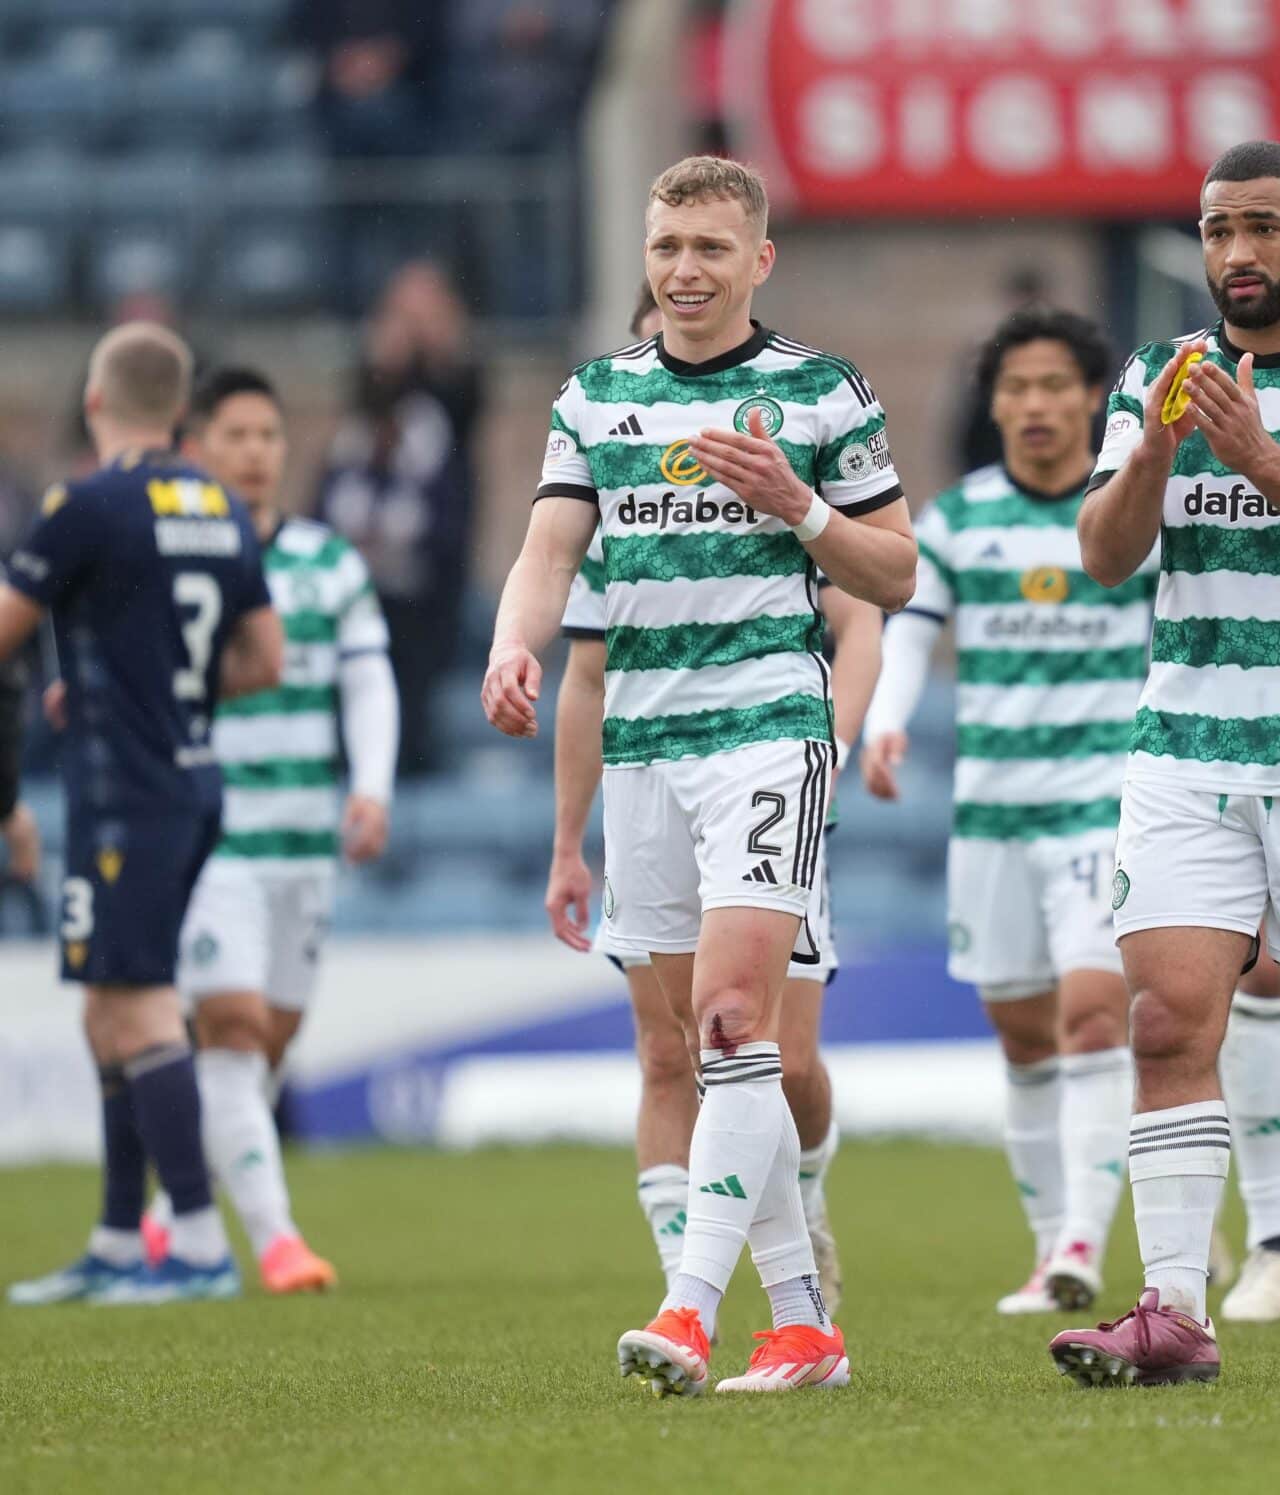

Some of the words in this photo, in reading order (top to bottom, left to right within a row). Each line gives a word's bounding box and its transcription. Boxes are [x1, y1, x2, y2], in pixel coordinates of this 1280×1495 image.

[800, 73, 1274, 177] SIGNS
[617, 491, 758, 530] dafabet
[172, 571, 222, 700] 3
[747, 790, 786, 857] 2
[1071, 851, 1099, 898] 4
[60, 876, 94, 941] 3
